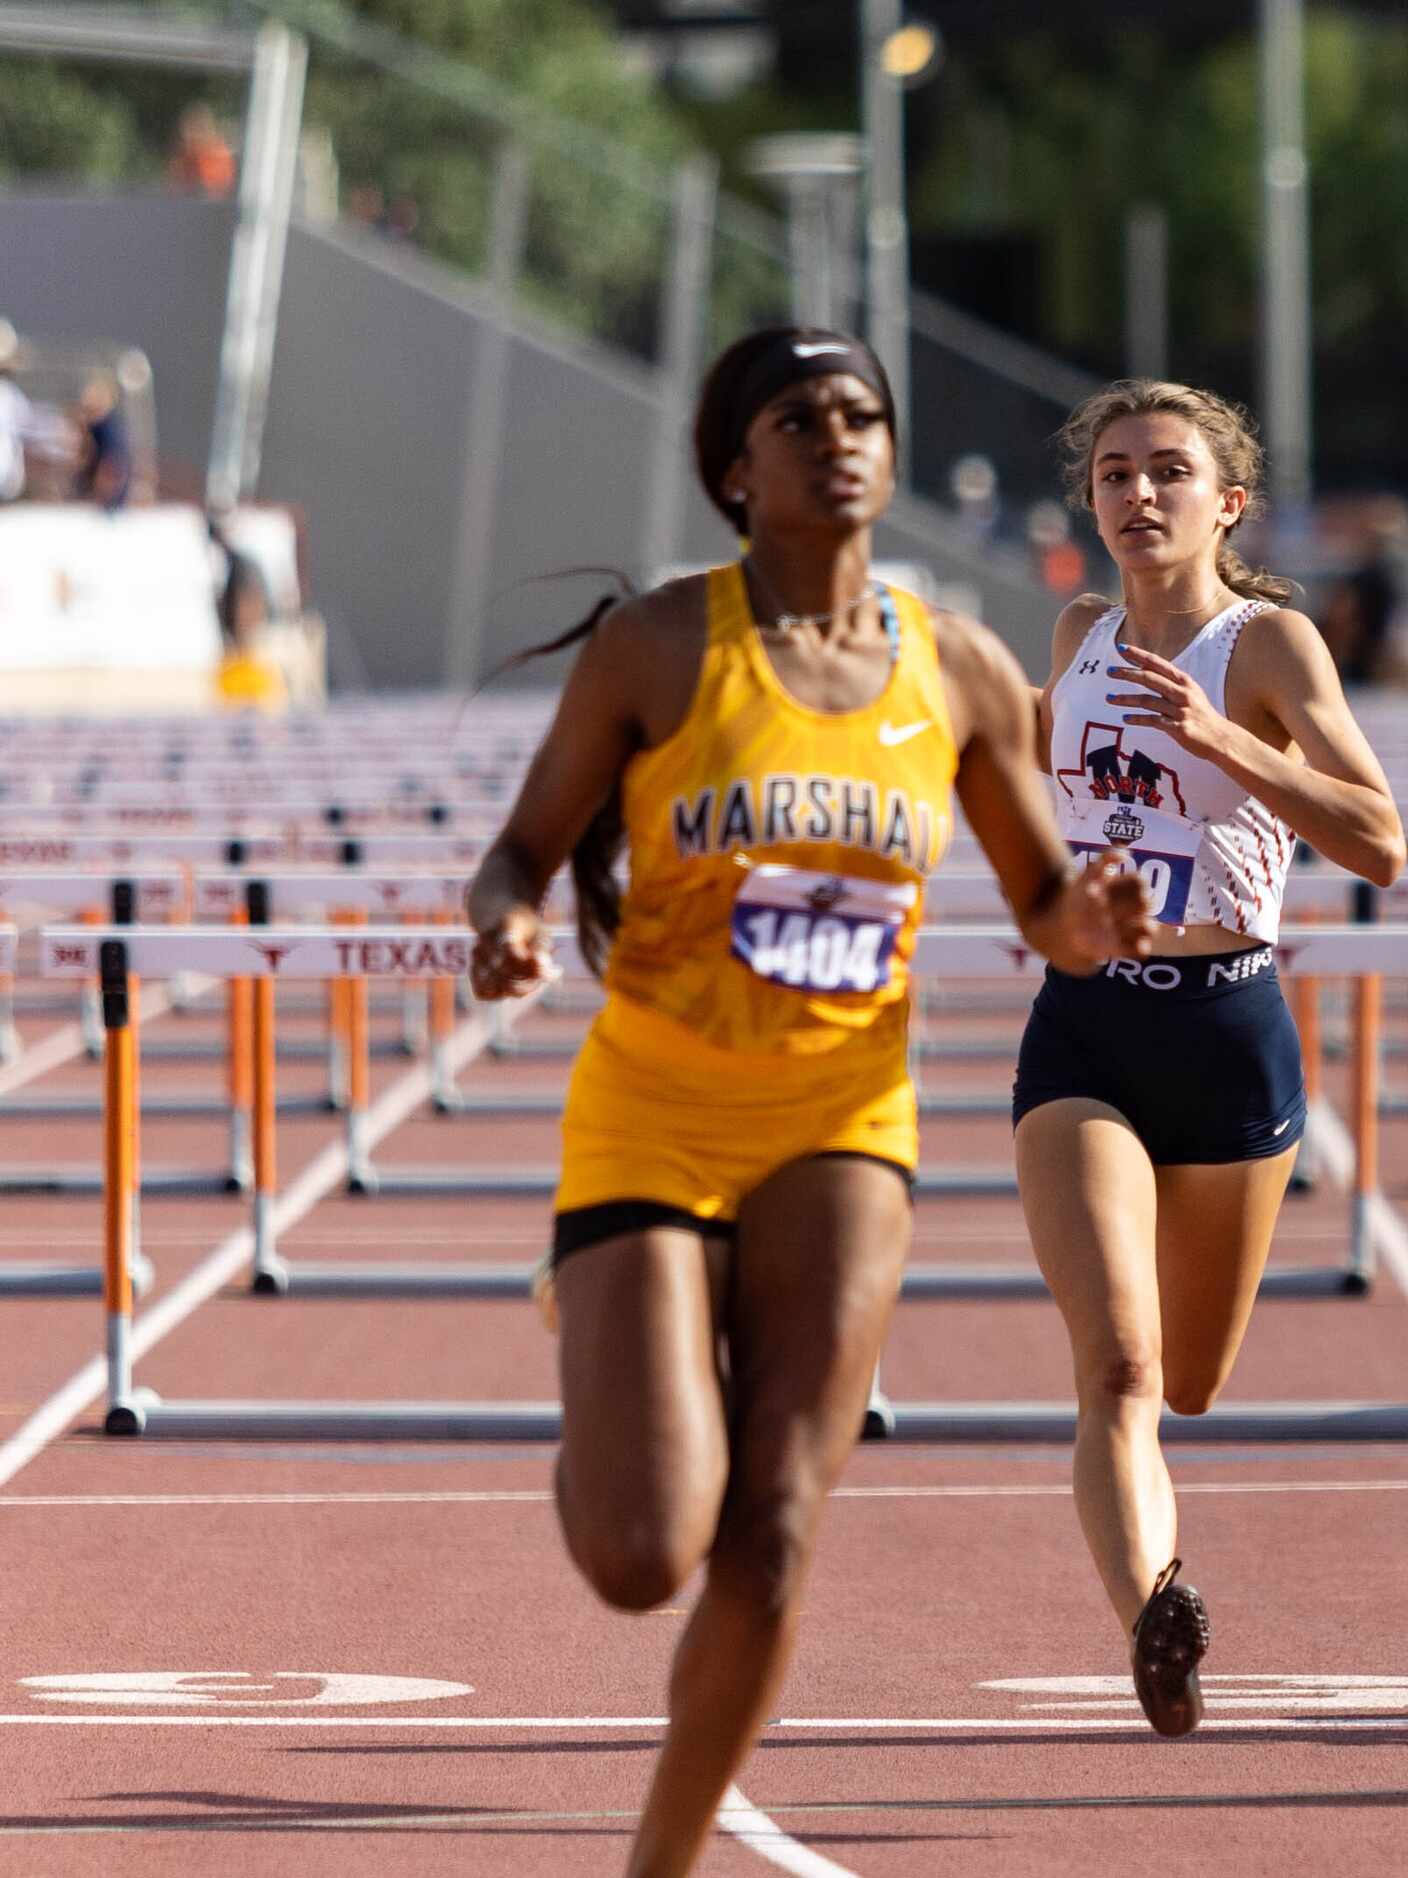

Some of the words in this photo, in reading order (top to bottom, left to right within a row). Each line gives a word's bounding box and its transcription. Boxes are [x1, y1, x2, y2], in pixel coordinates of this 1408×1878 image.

[1104, 821, 1144, 838] STATE
[332, 939, 467, 974] TEXAS
[746, 911, 885, 992] 1404
